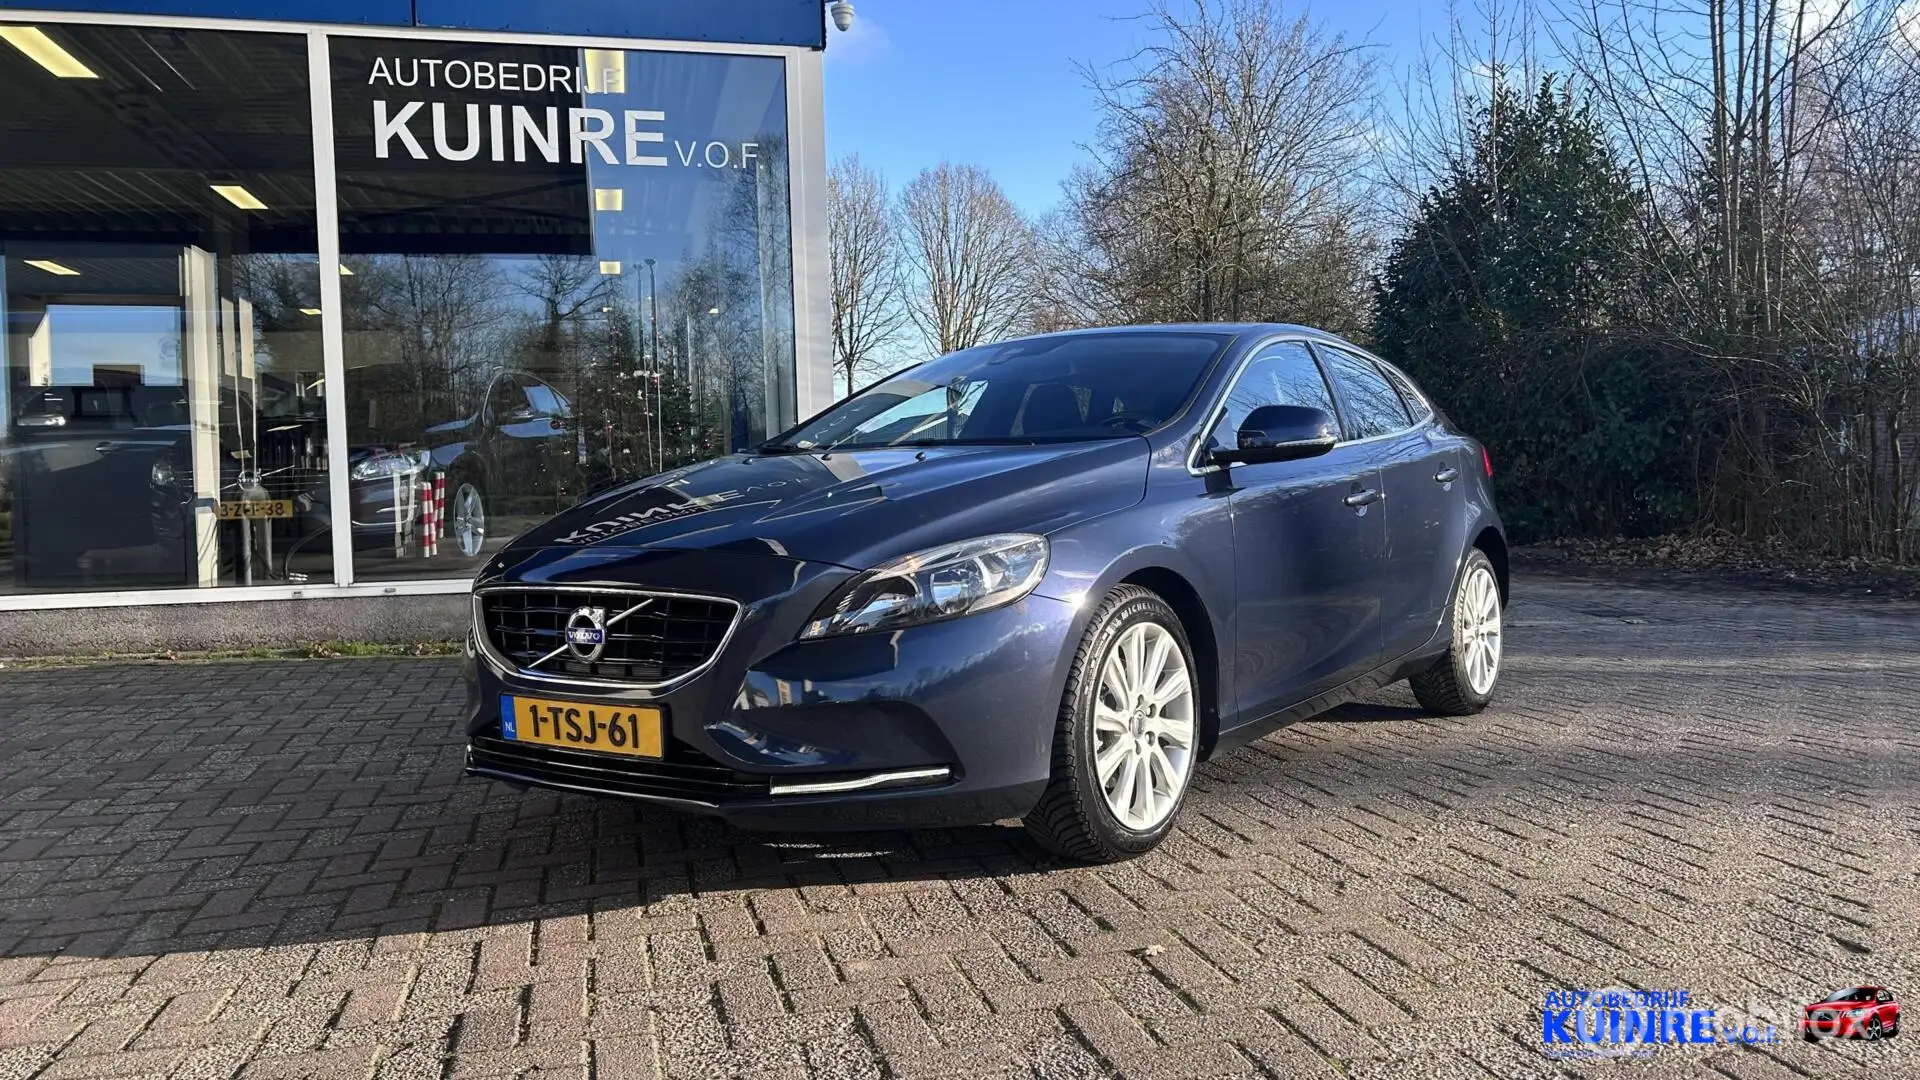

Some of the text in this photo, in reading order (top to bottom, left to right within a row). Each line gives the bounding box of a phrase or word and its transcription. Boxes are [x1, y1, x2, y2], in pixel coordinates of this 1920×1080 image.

[368, 57, 620, 95] AUTOBEDRIJF
[373, 100, 764, 169] KUINRE V.O.F.
[567, 630, 601, 641] VOLVO
[504, 704, 639, 748] NL 1-TSJ-61
